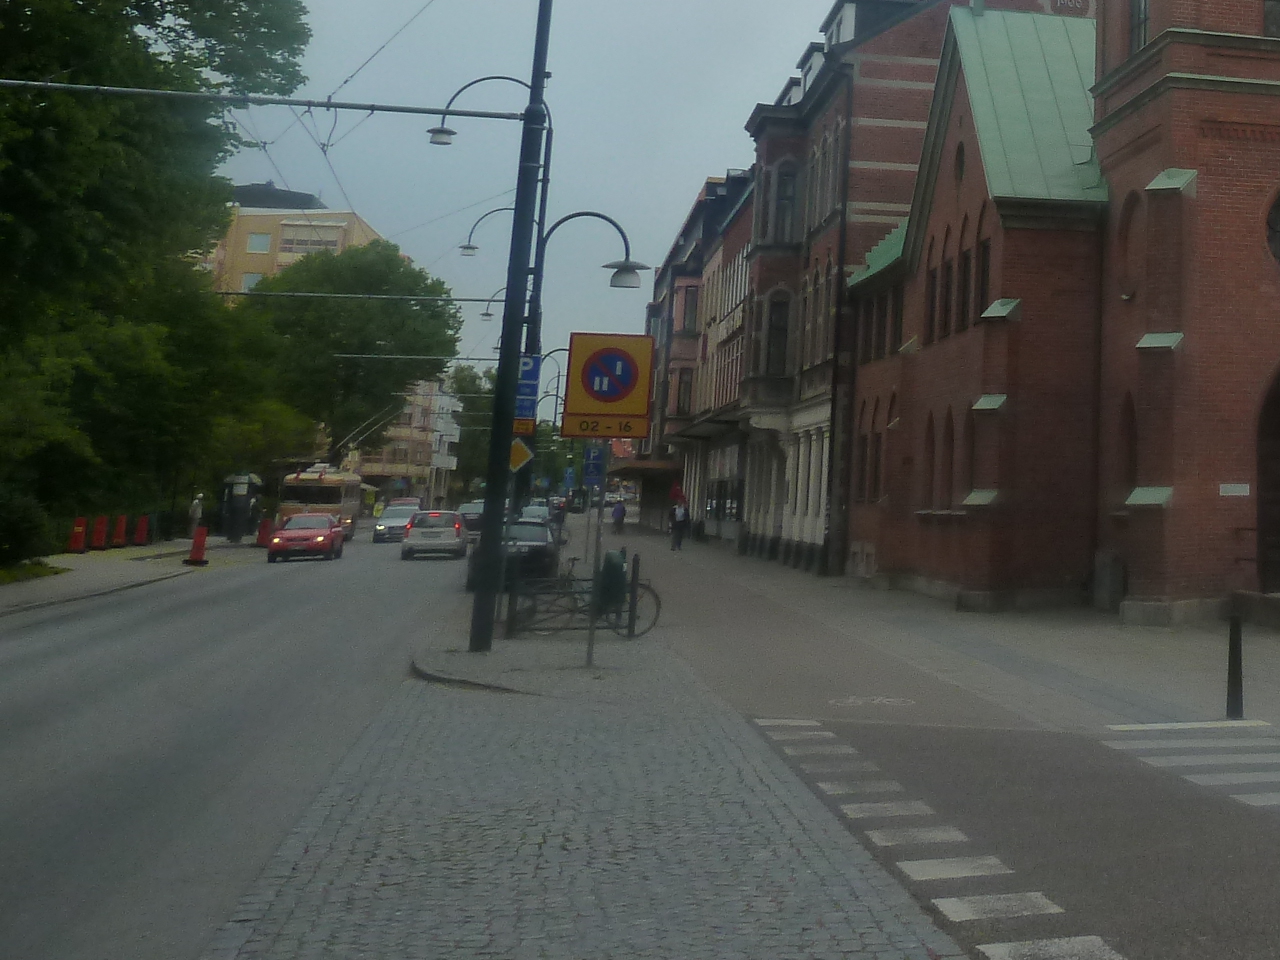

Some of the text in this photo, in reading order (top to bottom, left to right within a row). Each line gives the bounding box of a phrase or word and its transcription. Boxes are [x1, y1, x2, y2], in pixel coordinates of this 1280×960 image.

[518, 357, 533, 379] P
[580, 420, 599, 432] 02
[618, 420, 632, 432] 16
[590, 448, 598, 460] P
